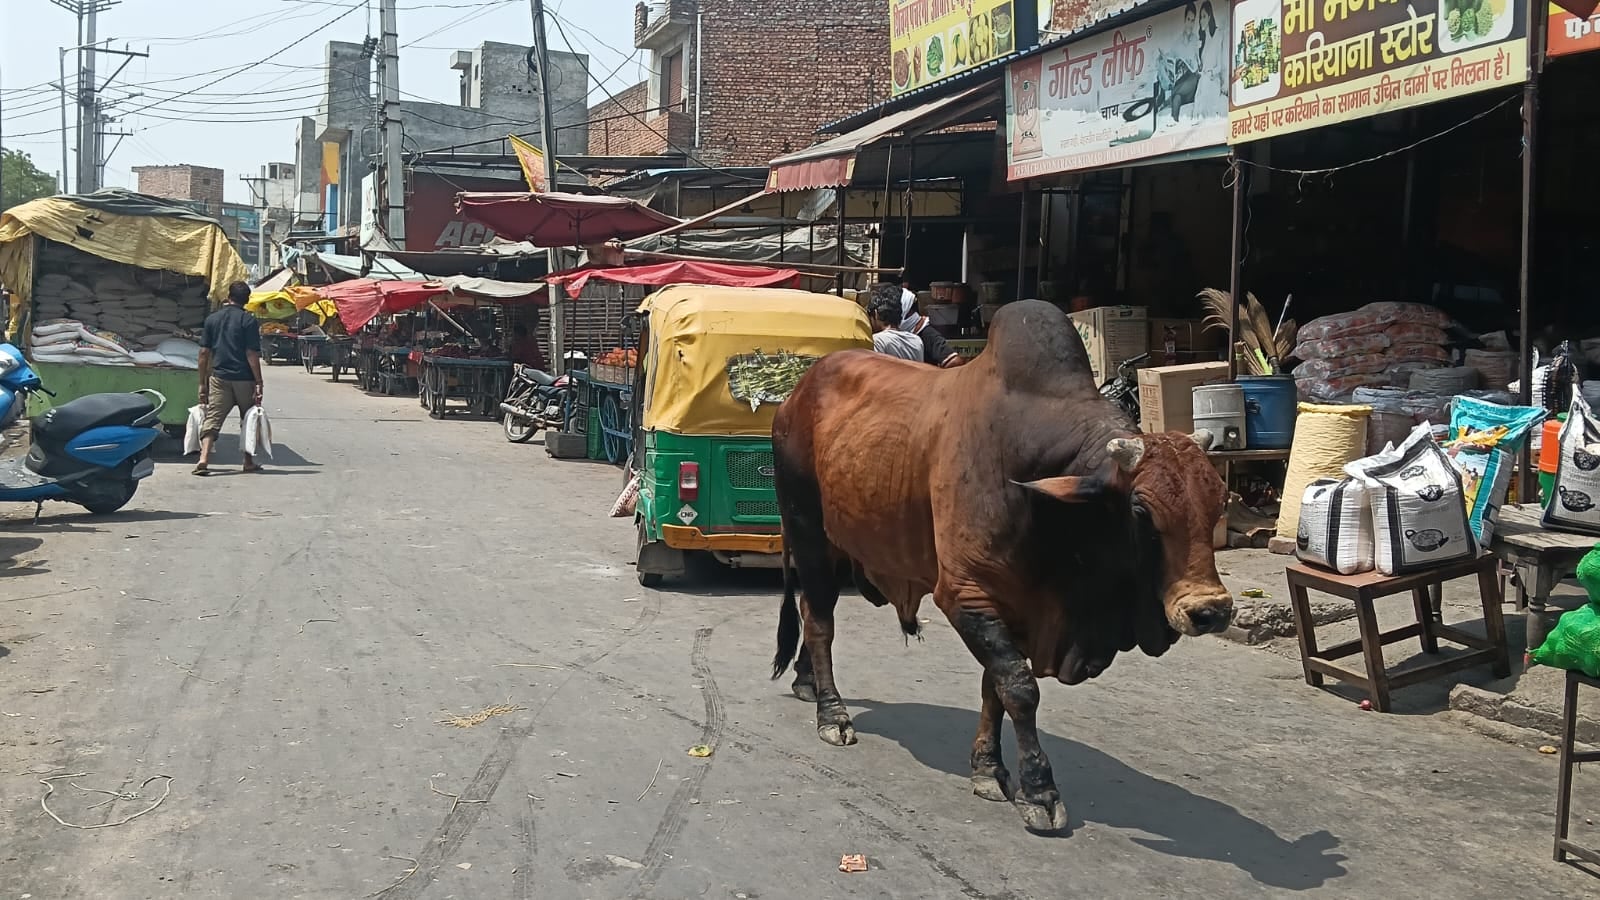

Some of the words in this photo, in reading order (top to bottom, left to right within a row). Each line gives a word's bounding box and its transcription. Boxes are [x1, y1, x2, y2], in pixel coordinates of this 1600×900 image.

[1048, 48, 1098, 99] गोल्ड
[1102, 30, 1146, 88] लीफ
[1284, 31, 1375, 88] करियाना
[1379, 3, 1436, 65] स्टोर
[1101, 104, 1119, 120] चाय
[1231, 111, 1252, 138] हमारे
[1254, 106, 1269, 132] यहां
[1272, 109, 1283, 127] पर
[1285, 96, 1320, 124] करियाने
[1322, 96, 1336, 115] का
[1339, 90, 1371, 113] सामान
[1373, 74, 1401, 104] उचित
[1404, 65, 1431, 96] दामों
[1432, 69, 1449, 90] पर
[1451, 57, 1491, 87] मिलता
